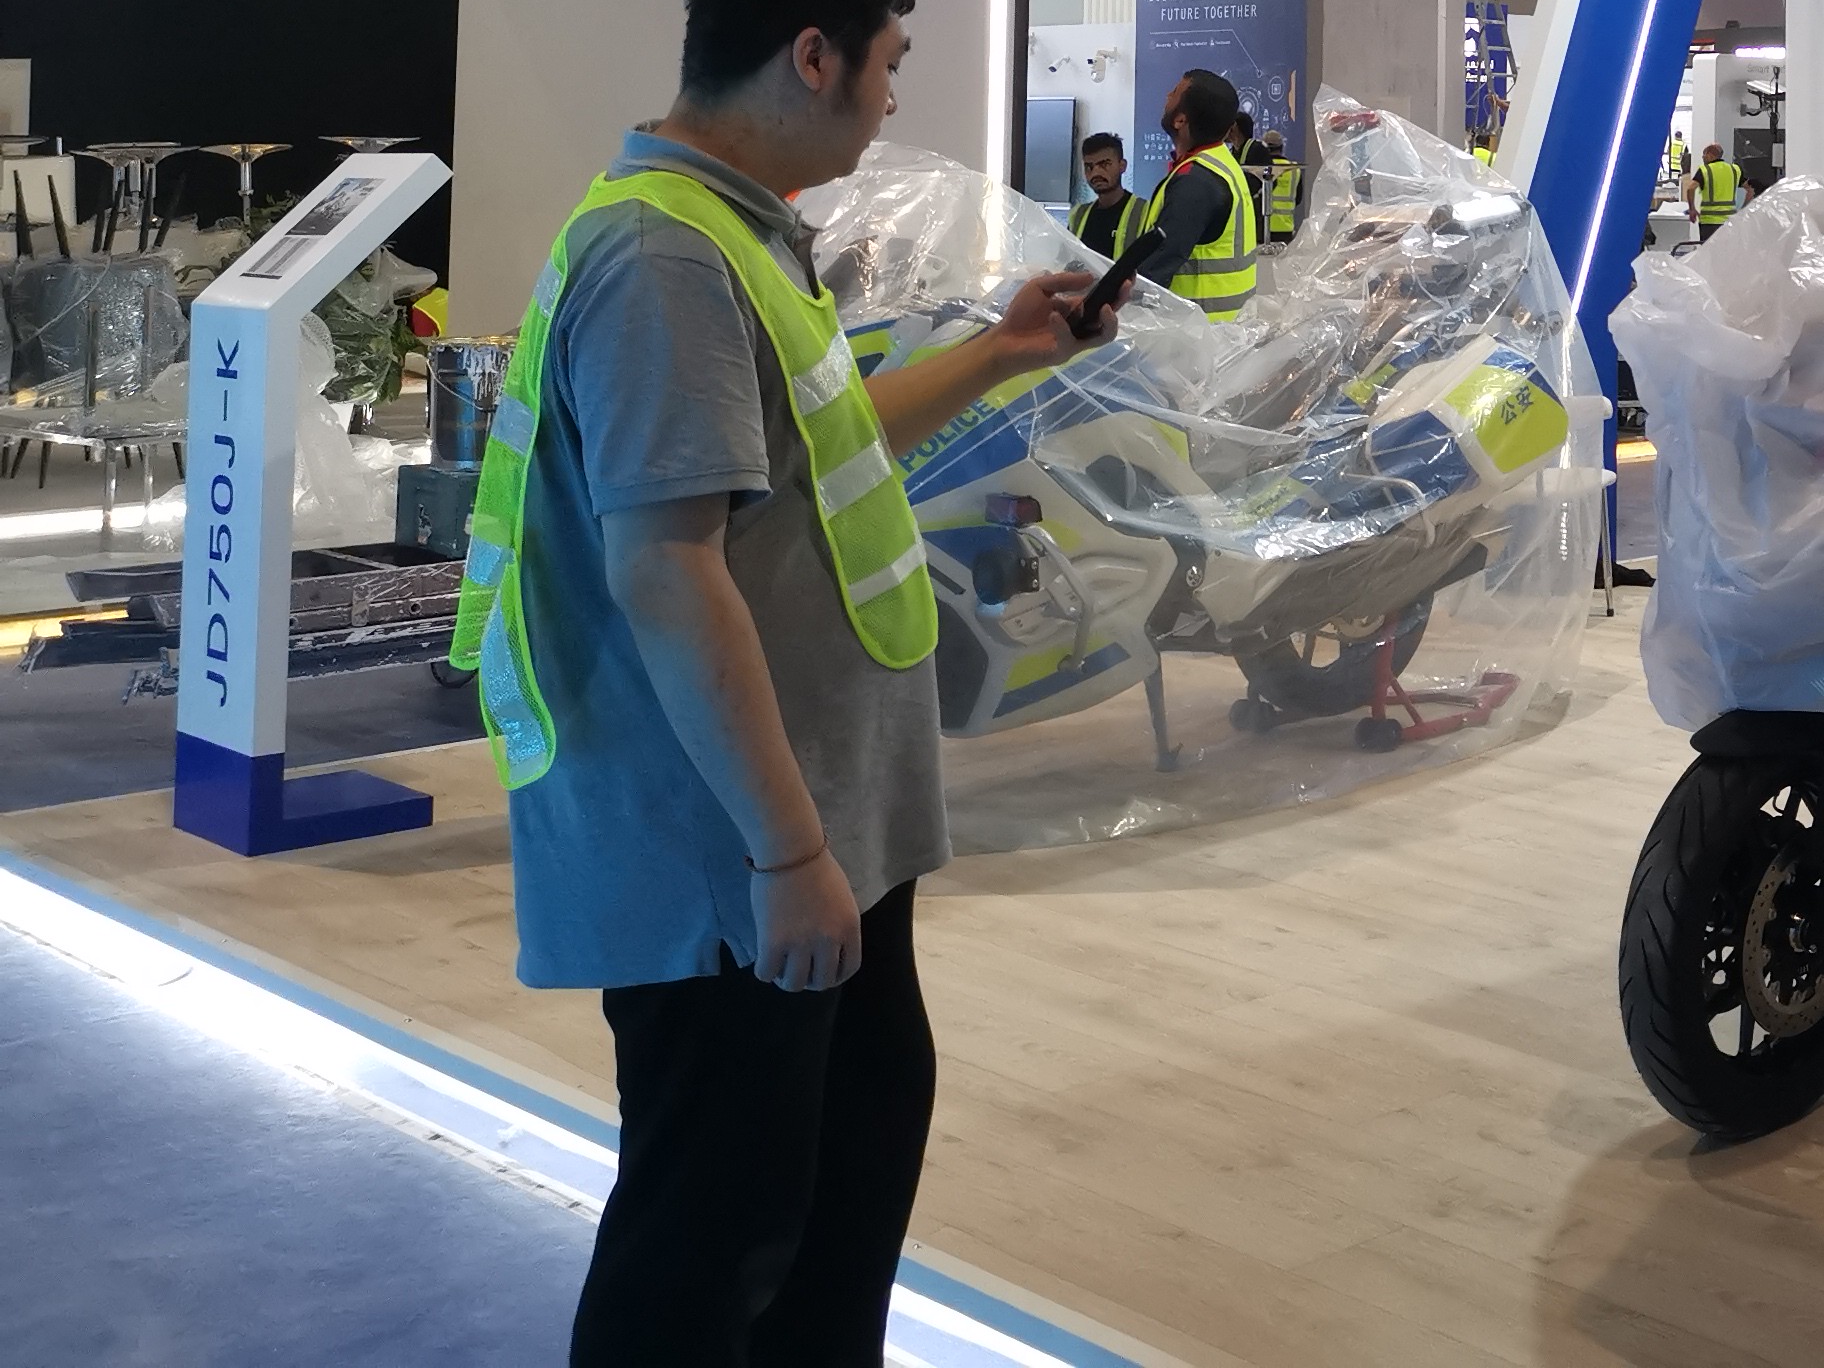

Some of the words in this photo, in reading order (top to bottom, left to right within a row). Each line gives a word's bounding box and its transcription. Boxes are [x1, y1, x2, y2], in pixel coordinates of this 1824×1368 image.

[1161, 7, 1200, 21] FUTURE
[1204, 4, 1258, 19] TOGETHER
[896, 395, 997, 473] POLICE
[1500, 385, 1534, 425] 公安
[205, 337, 240, 708] JD750J-K
